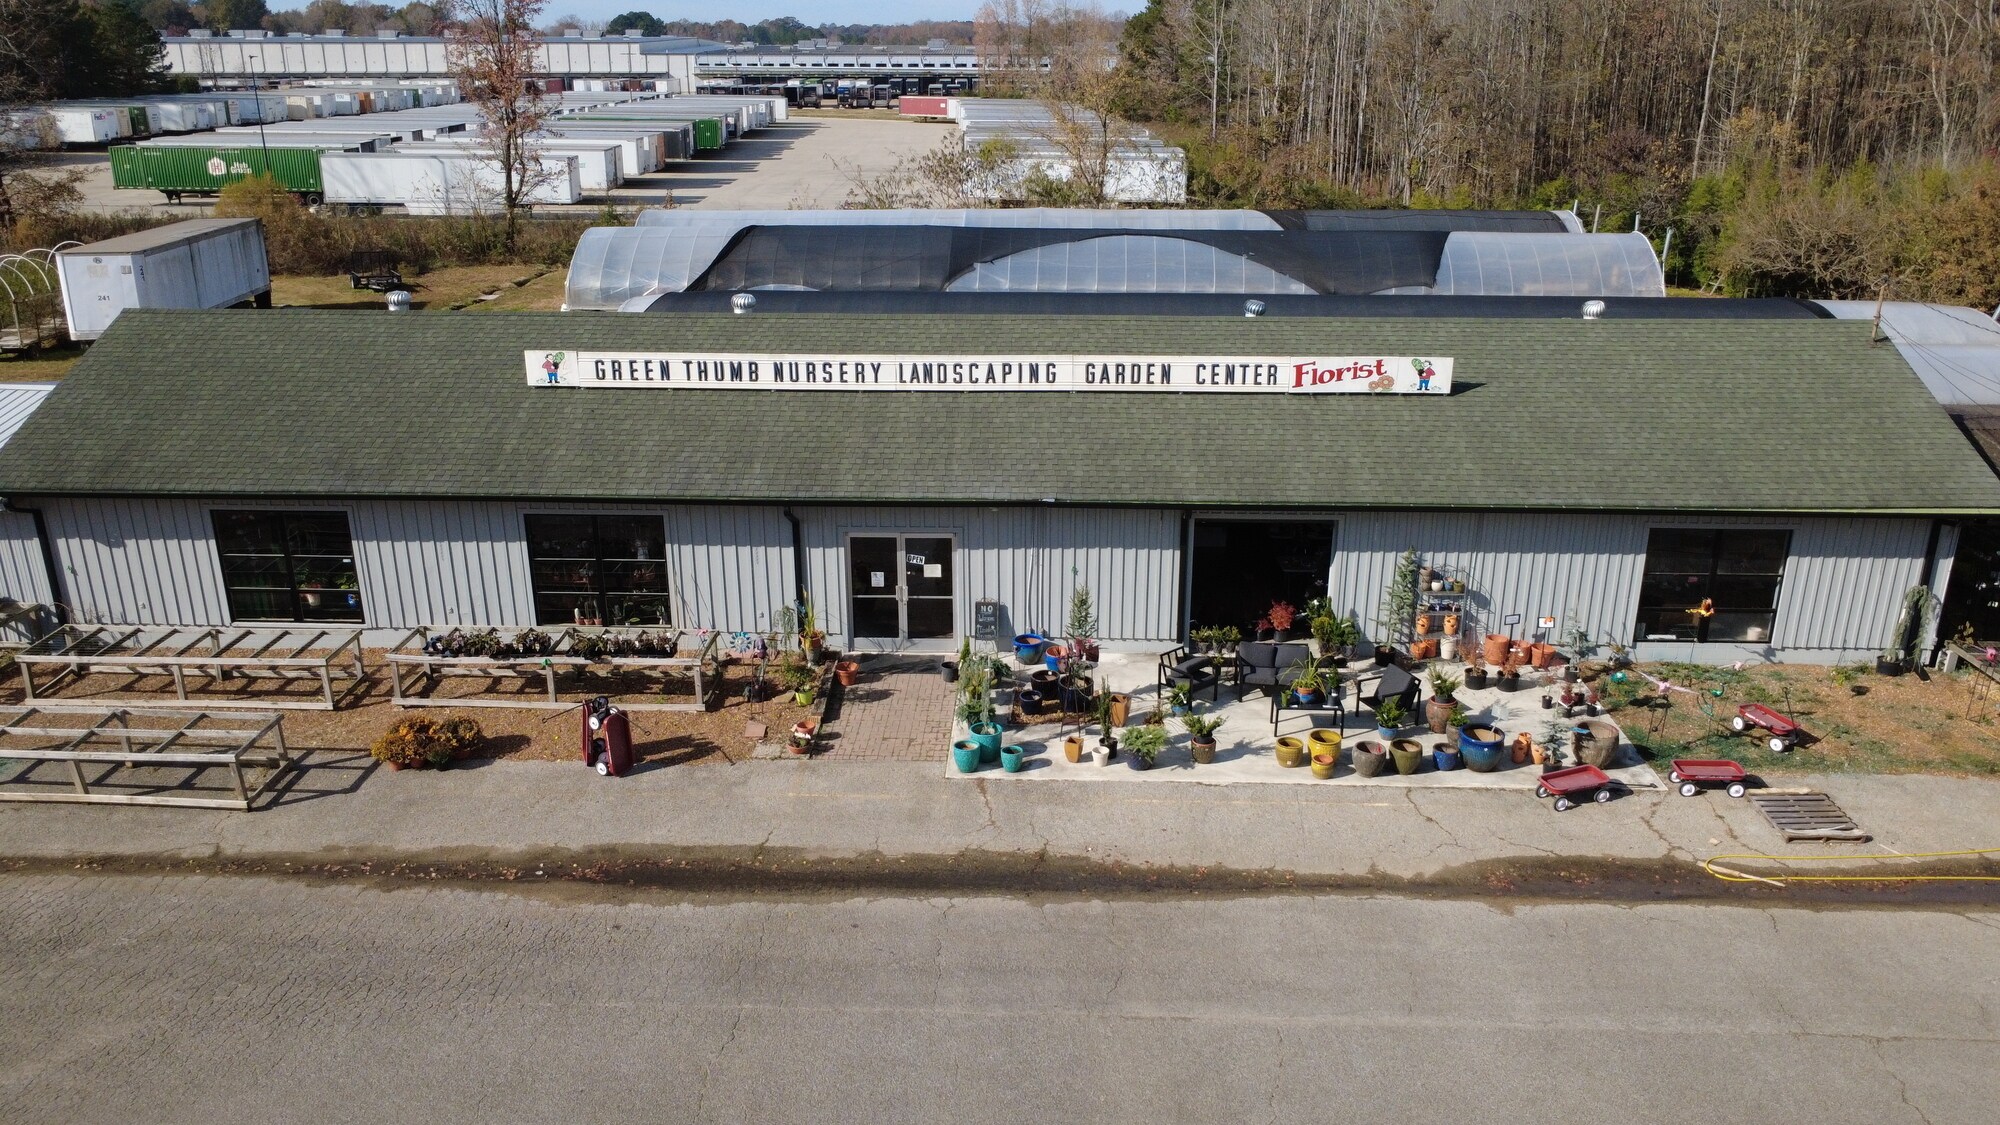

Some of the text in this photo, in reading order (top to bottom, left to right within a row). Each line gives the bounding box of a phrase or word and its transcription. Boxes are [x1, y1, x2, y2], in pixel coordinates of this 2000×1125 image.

[594, 359, 1278, 386] GREEN THUMB NURSERY LANDSCAPING GARDEN CENTER
[1291, 359, 1387, 388] Florist
[907, 554, 924, 565] OPEN
